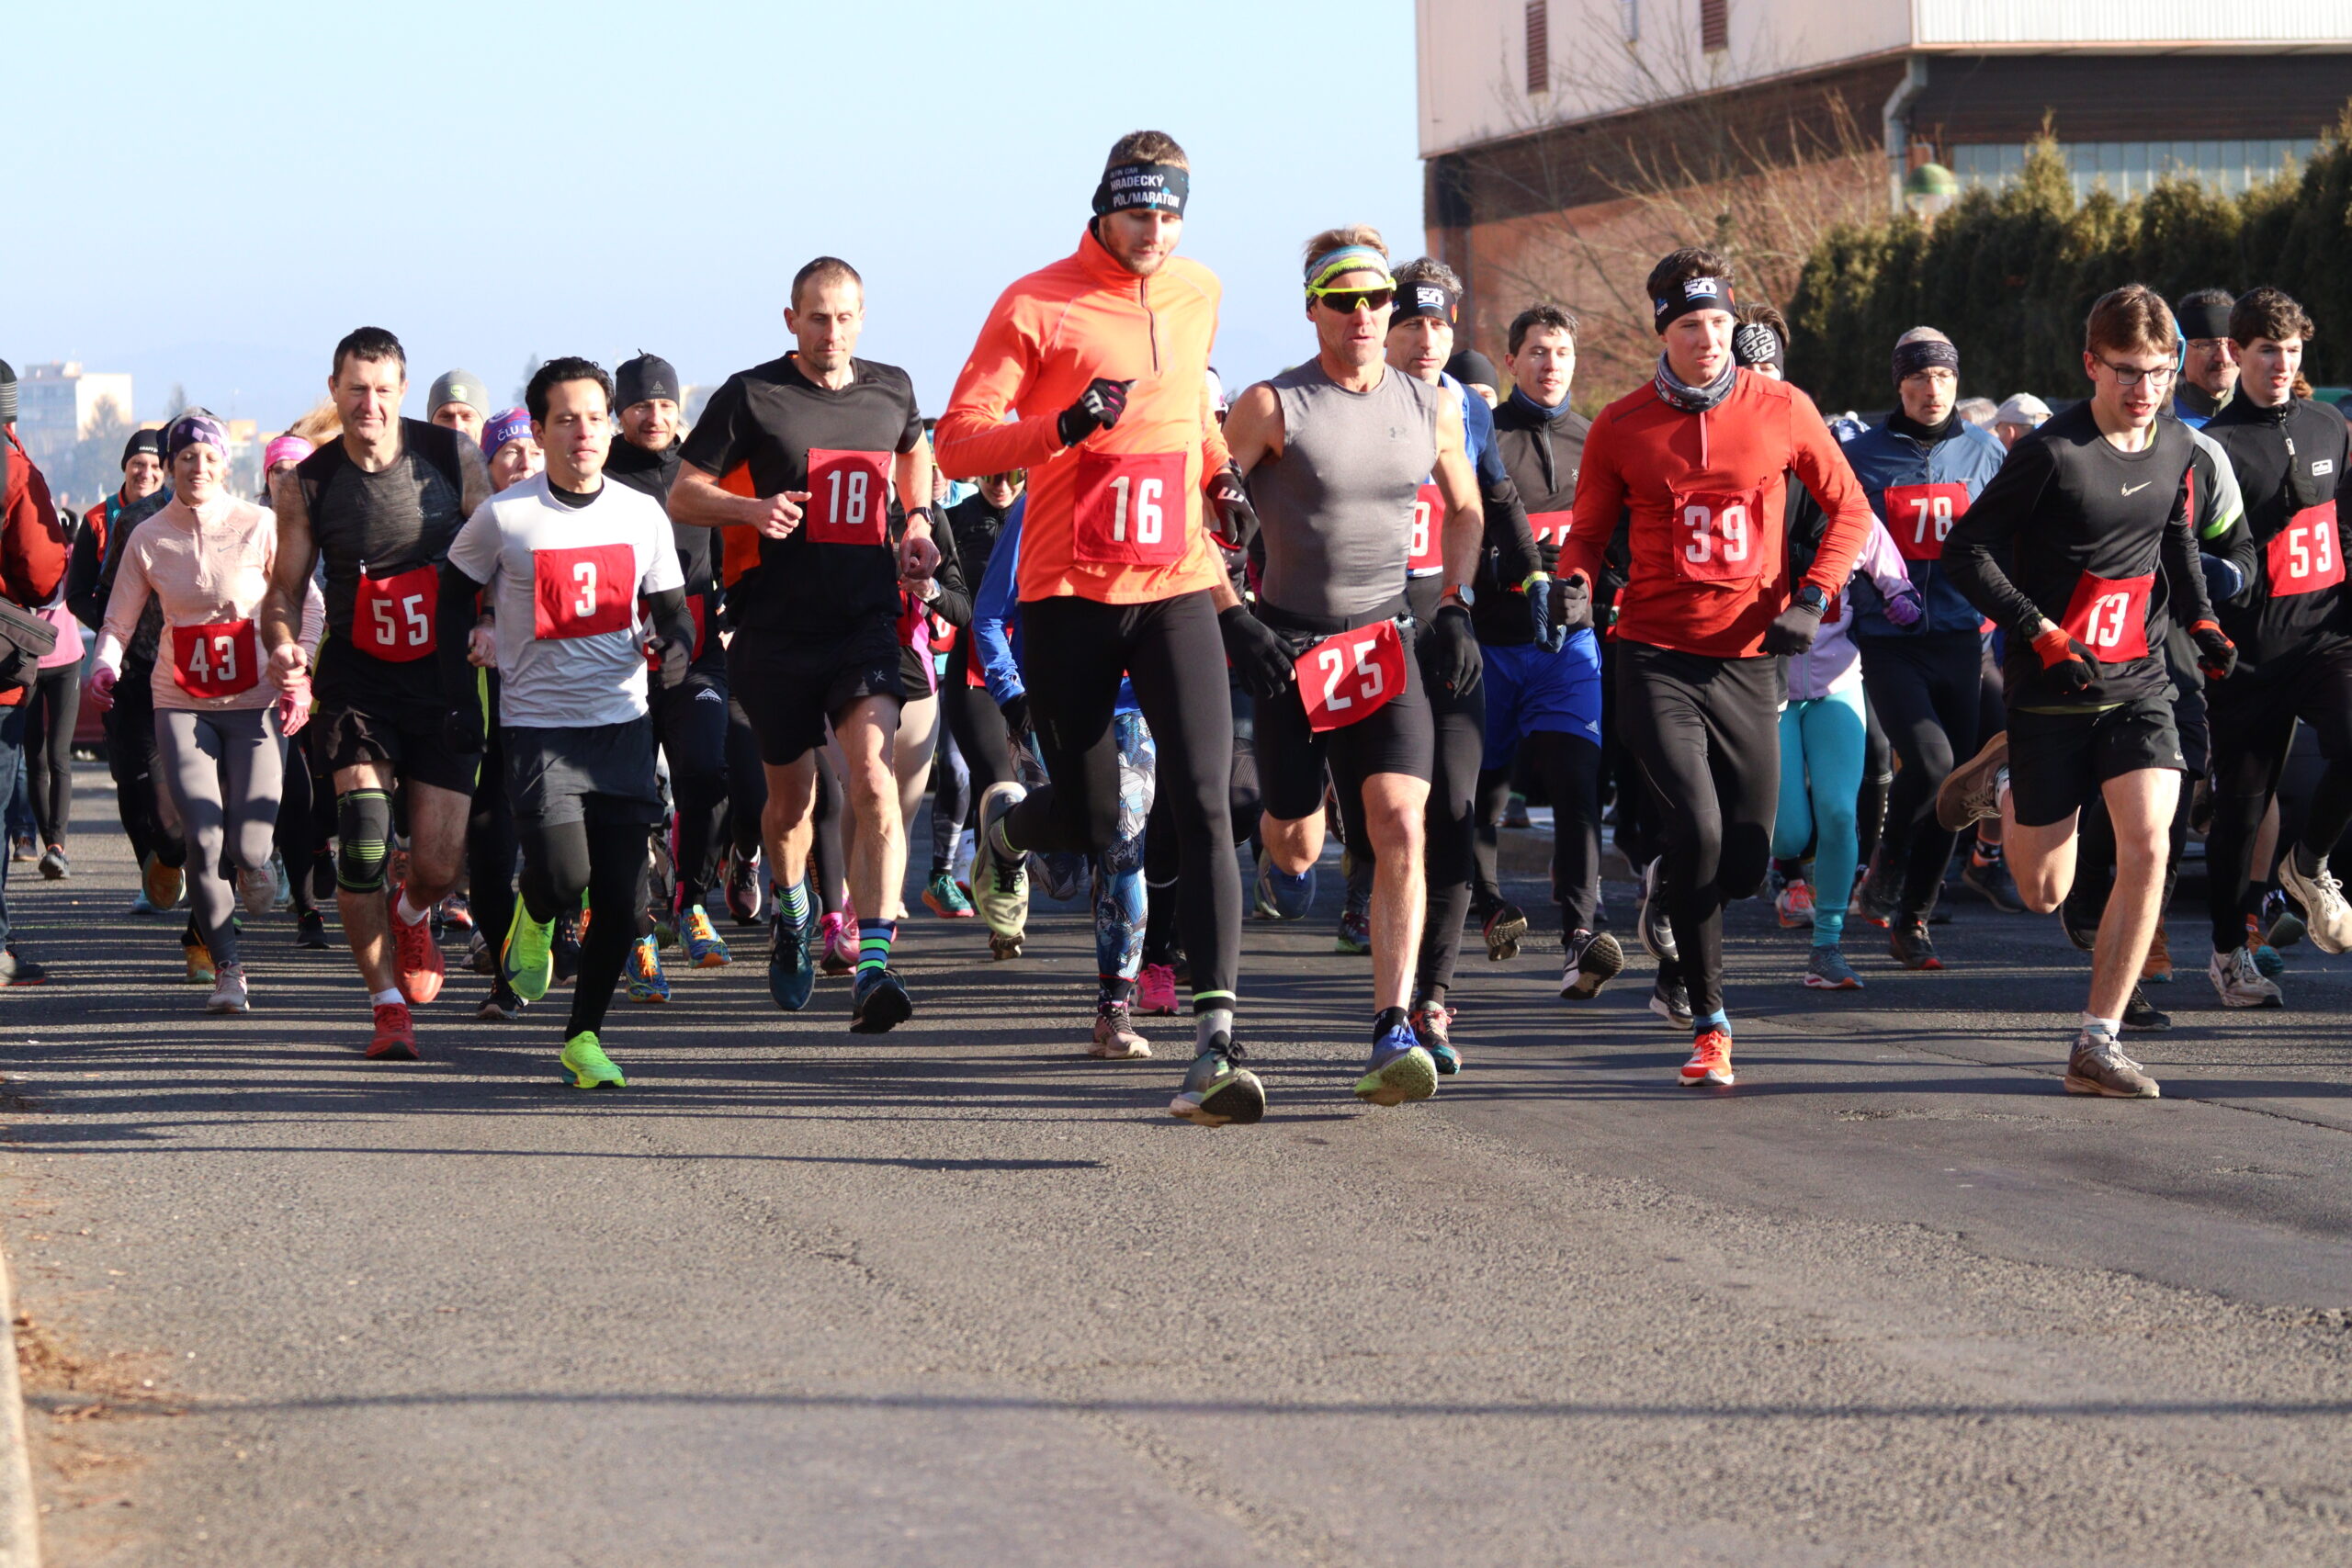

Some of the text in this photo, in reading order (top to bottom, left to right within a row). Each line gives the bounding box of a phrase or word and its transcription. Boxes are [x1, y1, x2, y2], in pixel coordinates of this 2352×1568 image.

[1110, 174, 1165, 191] HRADECKÝ
[1113, 191, 1181, 209] PŮL/MARATON
[1417, 290, 1445, 307] 50
[1684, 281, 1718, 299] 50
[827, 469, 868, 524] 18
[1109, 476, 1163, 544] 16
[1909, 496, 1953, 544] 78
[1409, 502, 1431, 557] 8
[1684, 505, 1747, 562] 39
[2290, 521, 2332, 578] 53
[573, 561, 597, 617] 3
[371, 593, 429, 646] 55
[2085, 592, 2130, 647] 13
[188, 636, 237, 682] 43
[1318, 639, 1384, 711] 25
